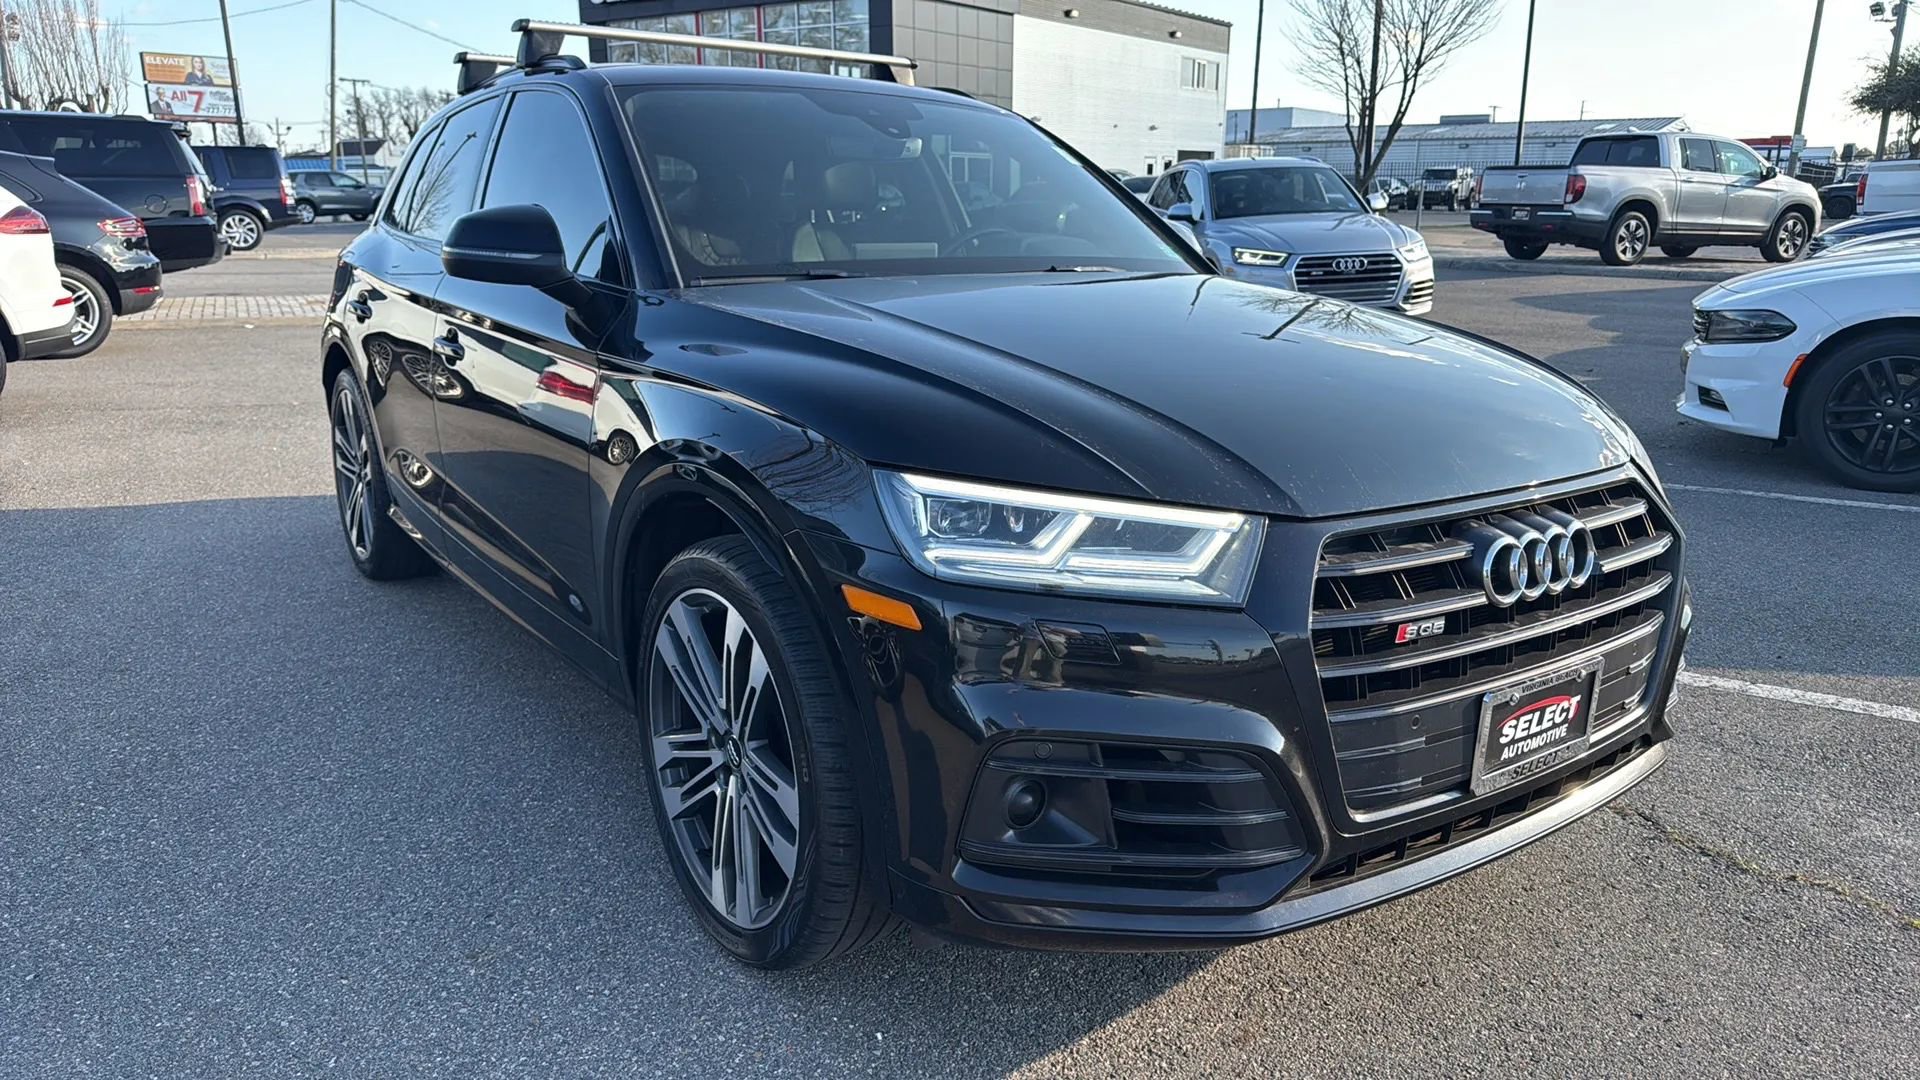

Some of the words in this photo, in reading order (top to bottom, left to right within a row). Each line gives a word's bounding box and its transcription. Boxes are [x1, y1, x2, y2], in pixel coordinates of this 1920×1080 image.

[145, 56, 185, 65] ELEVATE
[170, 90, 187, 102] All
[187, 90, 205, 113] 7
[1403, 620, 1445, 639] SQ5
[1521, 677, 1553, 693] VIRGINIA
[1555, 668, 1578, 682] BEACH
[1499, 694, 1582, 744] SELECT
[1501, 723, 1568, 760] AUTOMOTIVE
[1511, 751, 1558, 780] SELECT
